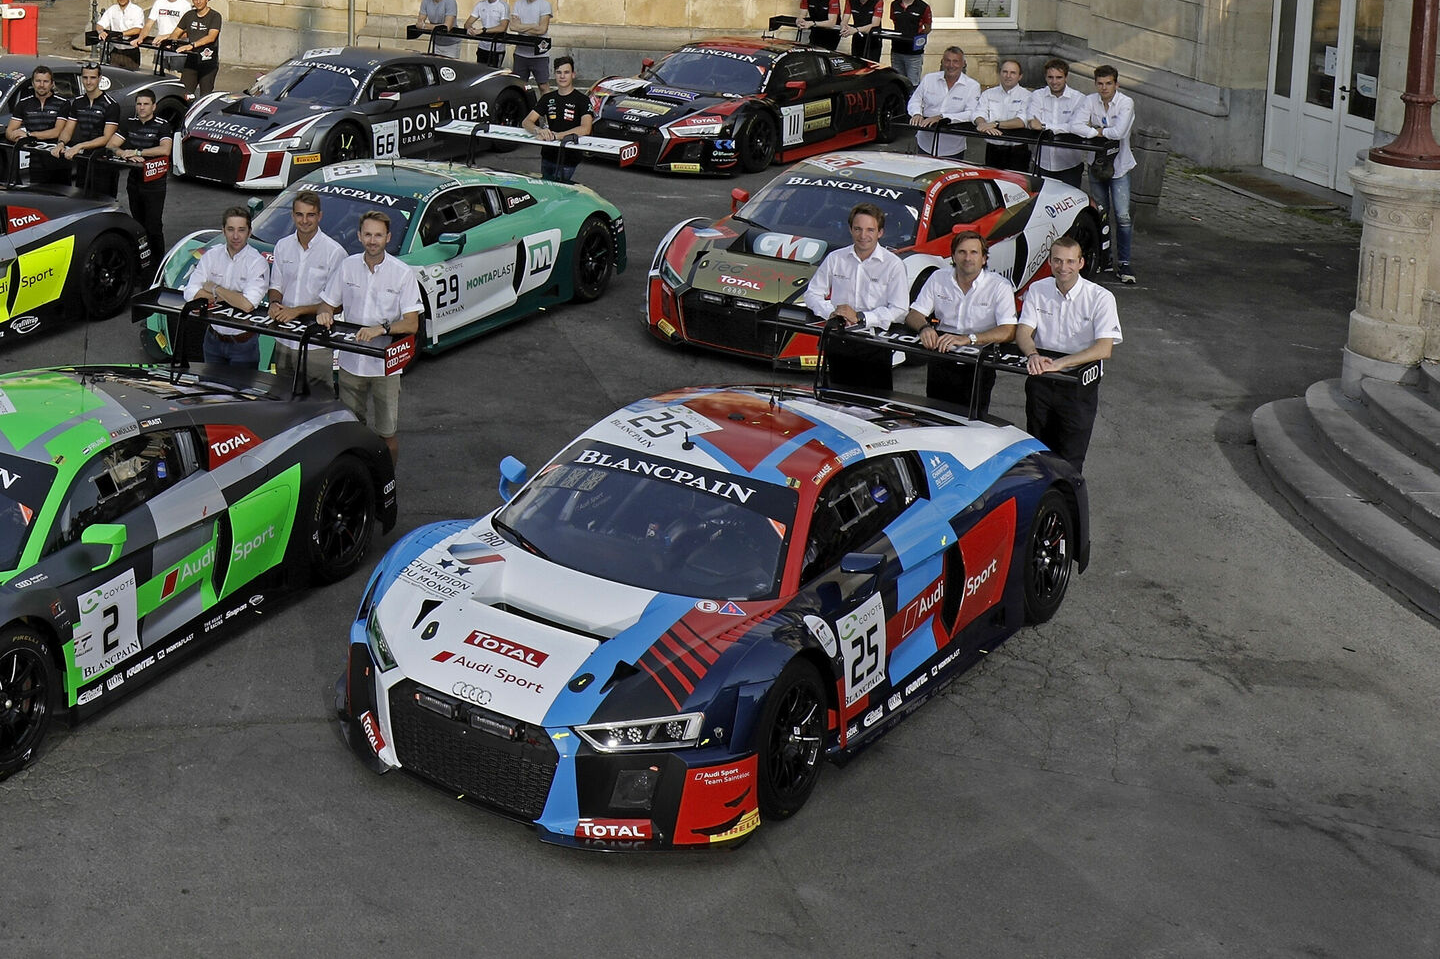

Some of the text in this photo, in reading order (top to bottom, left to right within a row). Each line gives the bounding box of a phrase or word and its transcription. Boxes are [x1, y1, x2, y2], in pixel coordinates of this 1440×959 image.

[681, 47, 757, 63] BLANCPAIN
[287, 60, 355, 76] BLANCPAIN
[652, 88, 692, 99] RAVENOL
[197, 119, 256, 137] DONIGER
[789, 114, 800, 136] 111
[203, 144, 220, 153] R8
[377, 133, 395, 156] 66
[145, 160, 167, 170] TOTAL
[298, 183, 399, 207] BLANCPAIN
[787, 176, 904, 201] BLANCPAIN
[1056, 197, 1077, 215] HUET
[9, 213, 41, 229] TOTAL
[532, 247, 552, 271] M
[21, 267, 54, 287] Sport
[467, 263, 515, 290] MONTAPLAST
[720, 275, 761, 290] TOTAL
[436, 274, 459, 309] 29
[386, 342, 411, 358] TOTAL
[116, 425, 138, 437] MÜLLER
[147, 417, 162, 427] RAST
[627, 411, 693, 438] 25
[210, 433, 251, 457] TOTAL
[610, 419, 655, 449] BLANCPAIN
[574, 449, 757, 504] BLANCPAIN
[478, 531, 506, 547] PRO
[181, 524, 275, 582] Audi Sport
[400, 566, 416, 578] DU
[418, 576, 460, 598] MONDE
[410, 559, 471, 591] CHAMPION
[104, 577, 134, 600] COYOTE
[918, 559, 997, 618] Audi Sport
[859, 603, 883, 625] COYOTE
[103, 604, 119, 655] 2
[166, 633, 194, 654] MONTAPLAST
[472, 631, 538, 666] TOTAL
[84, 640, 139, 678] BLANCPAIN
[851, 623, 879, 688] 25
[453, 655, 544, 694] Audi Sport
[845, 668, 885, 707] BLANCPAIN
[362, 716, 381, 752] TOTAL
[703, 768, 739, 779] Audi Sport
[704, 778, 723, 786] Team
[579, 823, 645, 837] TOTAL
